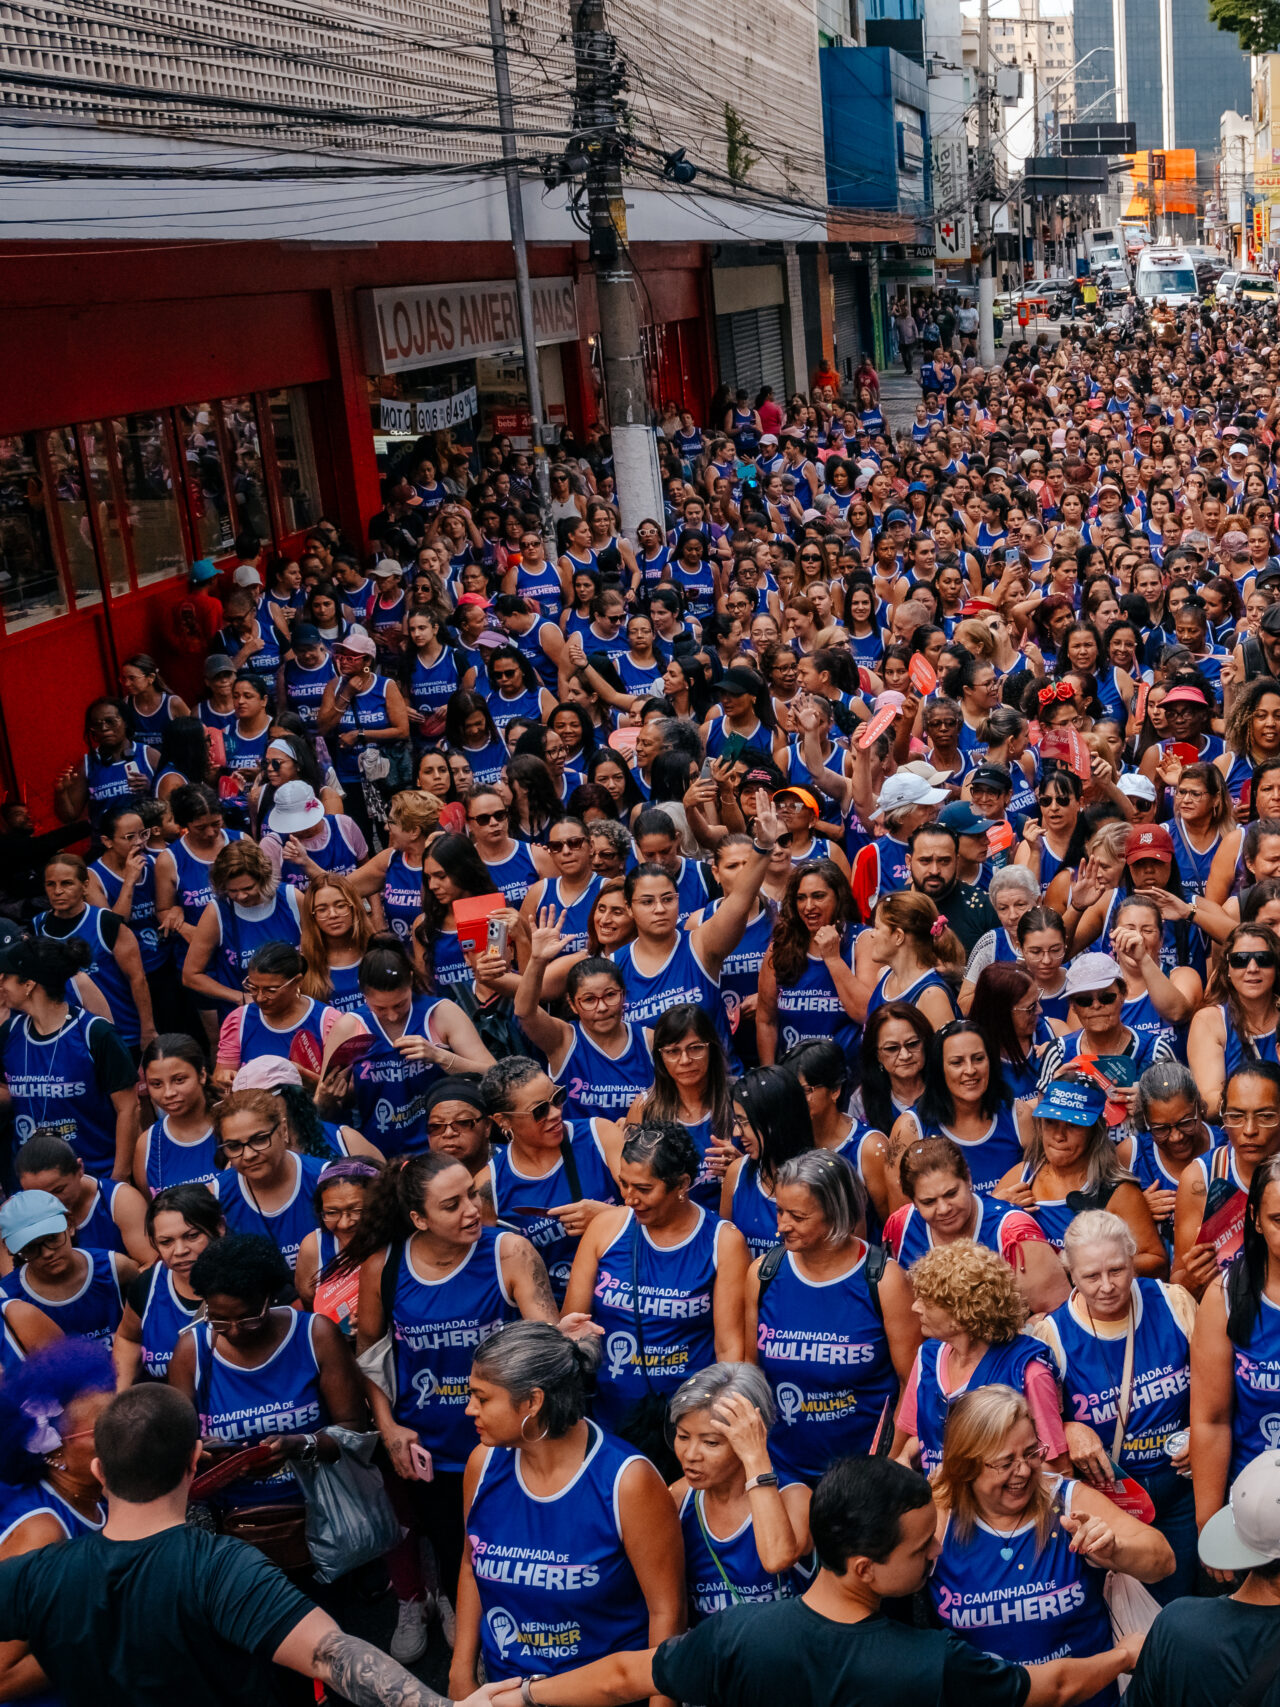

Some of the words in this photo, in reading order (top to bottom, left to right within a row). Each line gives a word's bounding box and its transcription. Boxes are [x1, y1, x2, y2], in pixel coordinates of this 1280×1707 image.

[377, 297, 455, 360] LOJAS
[460, 286, 574, 347] AMERIANAS
[863, 709, 895, 745] MULHERES
[631, 992, 675, 1009] CAMINHADA
[302, 1033, 320, 1072] MULHERES
[580, 1092, 637, 1107] MULHE
[680, 1290, 690, 1298] DE
[603, 1290, 710, 1319] MULHERES
[404, 1321, 468, 1335] CAMINHADA
[469, 1319, 479, 1327] DE
[776, 1330, 838, 1341] CAMINHADA
[766, 1344, 875, 1365] MULHERES
[435, 1385, 470, 1395] MULH
[1101, 1368, 1163, 1400] CAMHADA
[1163, 1365, 1173, 1375] DE
[449, 1396, 470, 1404] MEN
[213, 1402, 282, 1424] CAMINHADA
[283, 1400, 294, 1409] DE
[1124, 1435, 1167, 1450] MULH
[1139, 1450, 1165, 1460] MEN
[488, 1545, 555, 1561] CAMINHADA
[557, 1554, 569, 1563] DE
[476, 1561, 599, 1590] MULHERES
[761, 1583, 774, 1591] DE
[964, 1581, 1044, 1605] CAMINHADA
[1045, 1580, 1056, 1590] DE
[952, 1584, 1085, 1628] MULHERES
